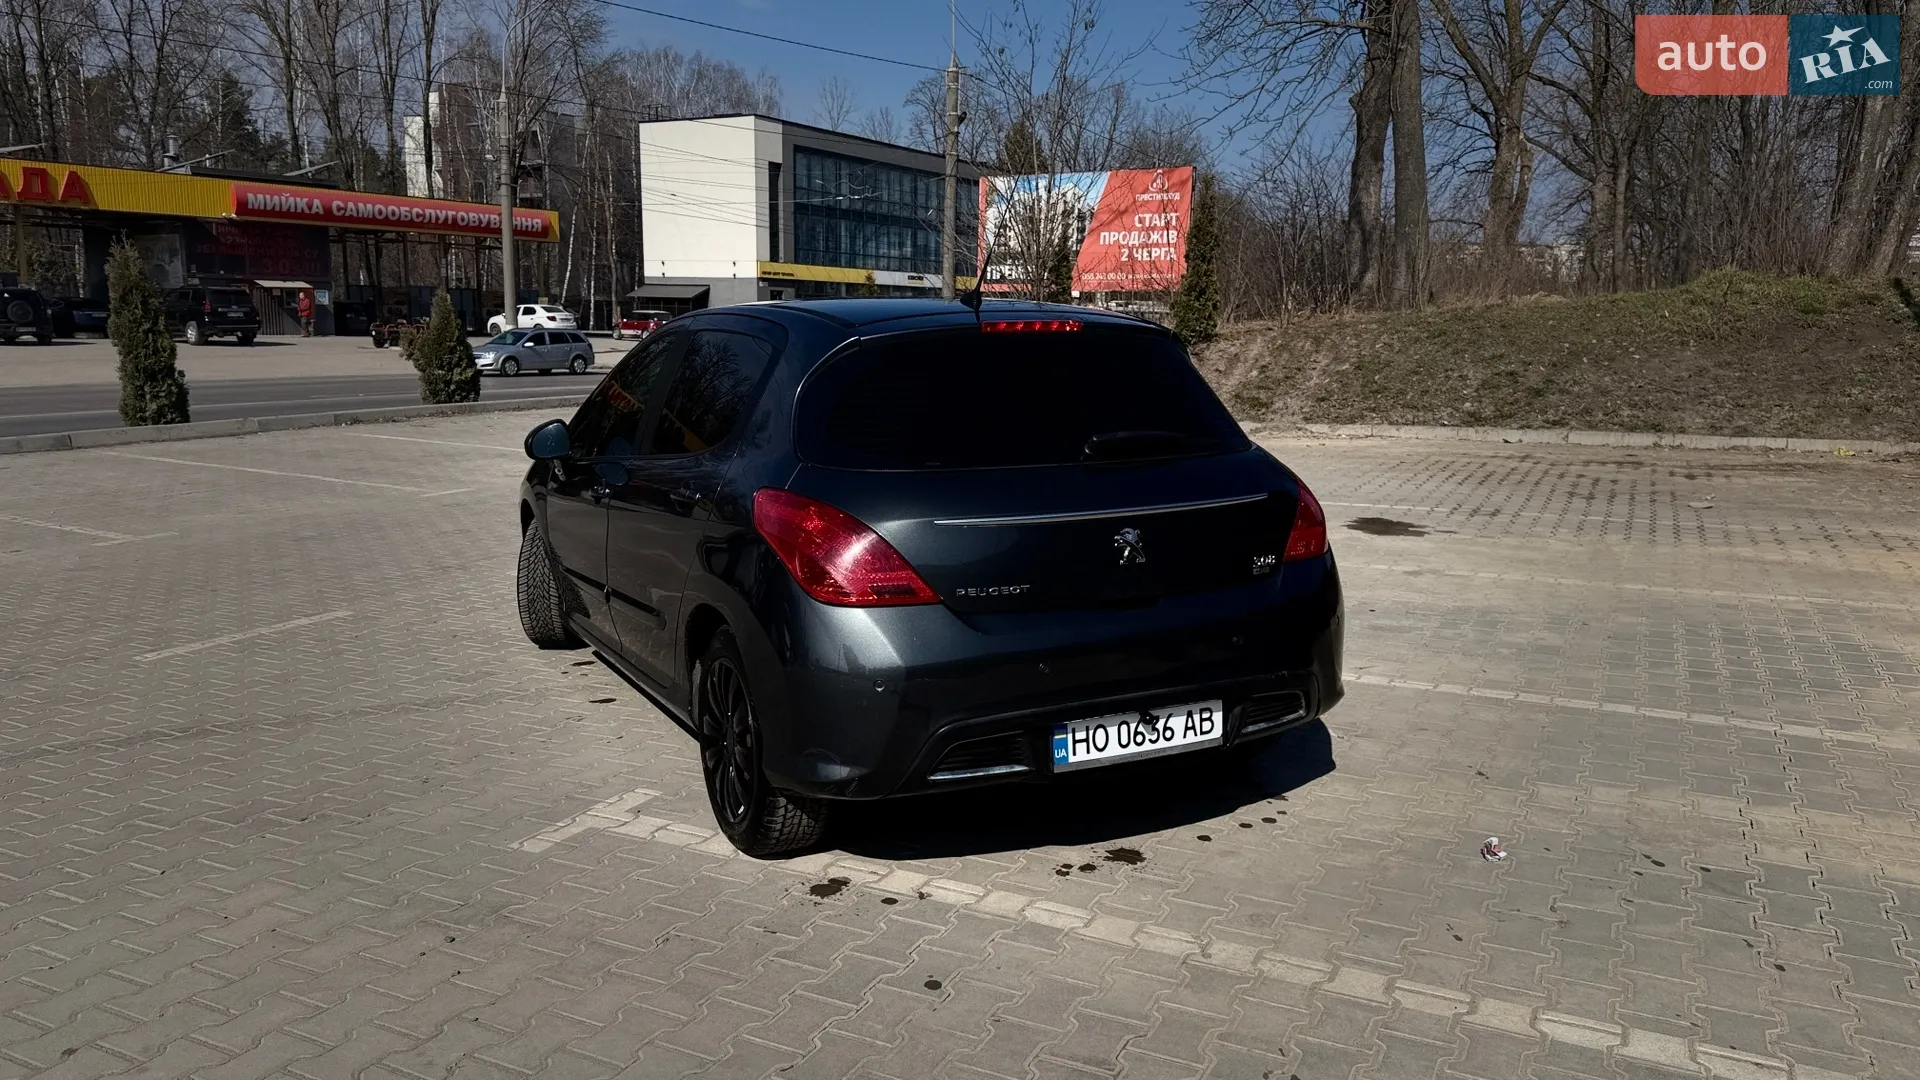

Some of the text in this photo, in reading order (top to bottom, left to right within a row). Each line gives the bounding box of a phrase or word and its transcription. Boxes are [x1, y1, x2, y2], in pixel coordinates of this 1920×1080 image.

[247, 192, 543, 233] МИЙКА САМООБСЛУГОВУВННЯ
[1134, 213, 1179, 228] СТАРТ
[1099, 230, 1178, 247] ПРОДАЖІВ
[1121, 247, 1177, 261] 2 ЧЕРГА
[956, 585, 1030, 597] PEUGEOT
[1071, 706, 1215, 757] HO 0636 AB
[1054, 748, 1068, 759] UA
